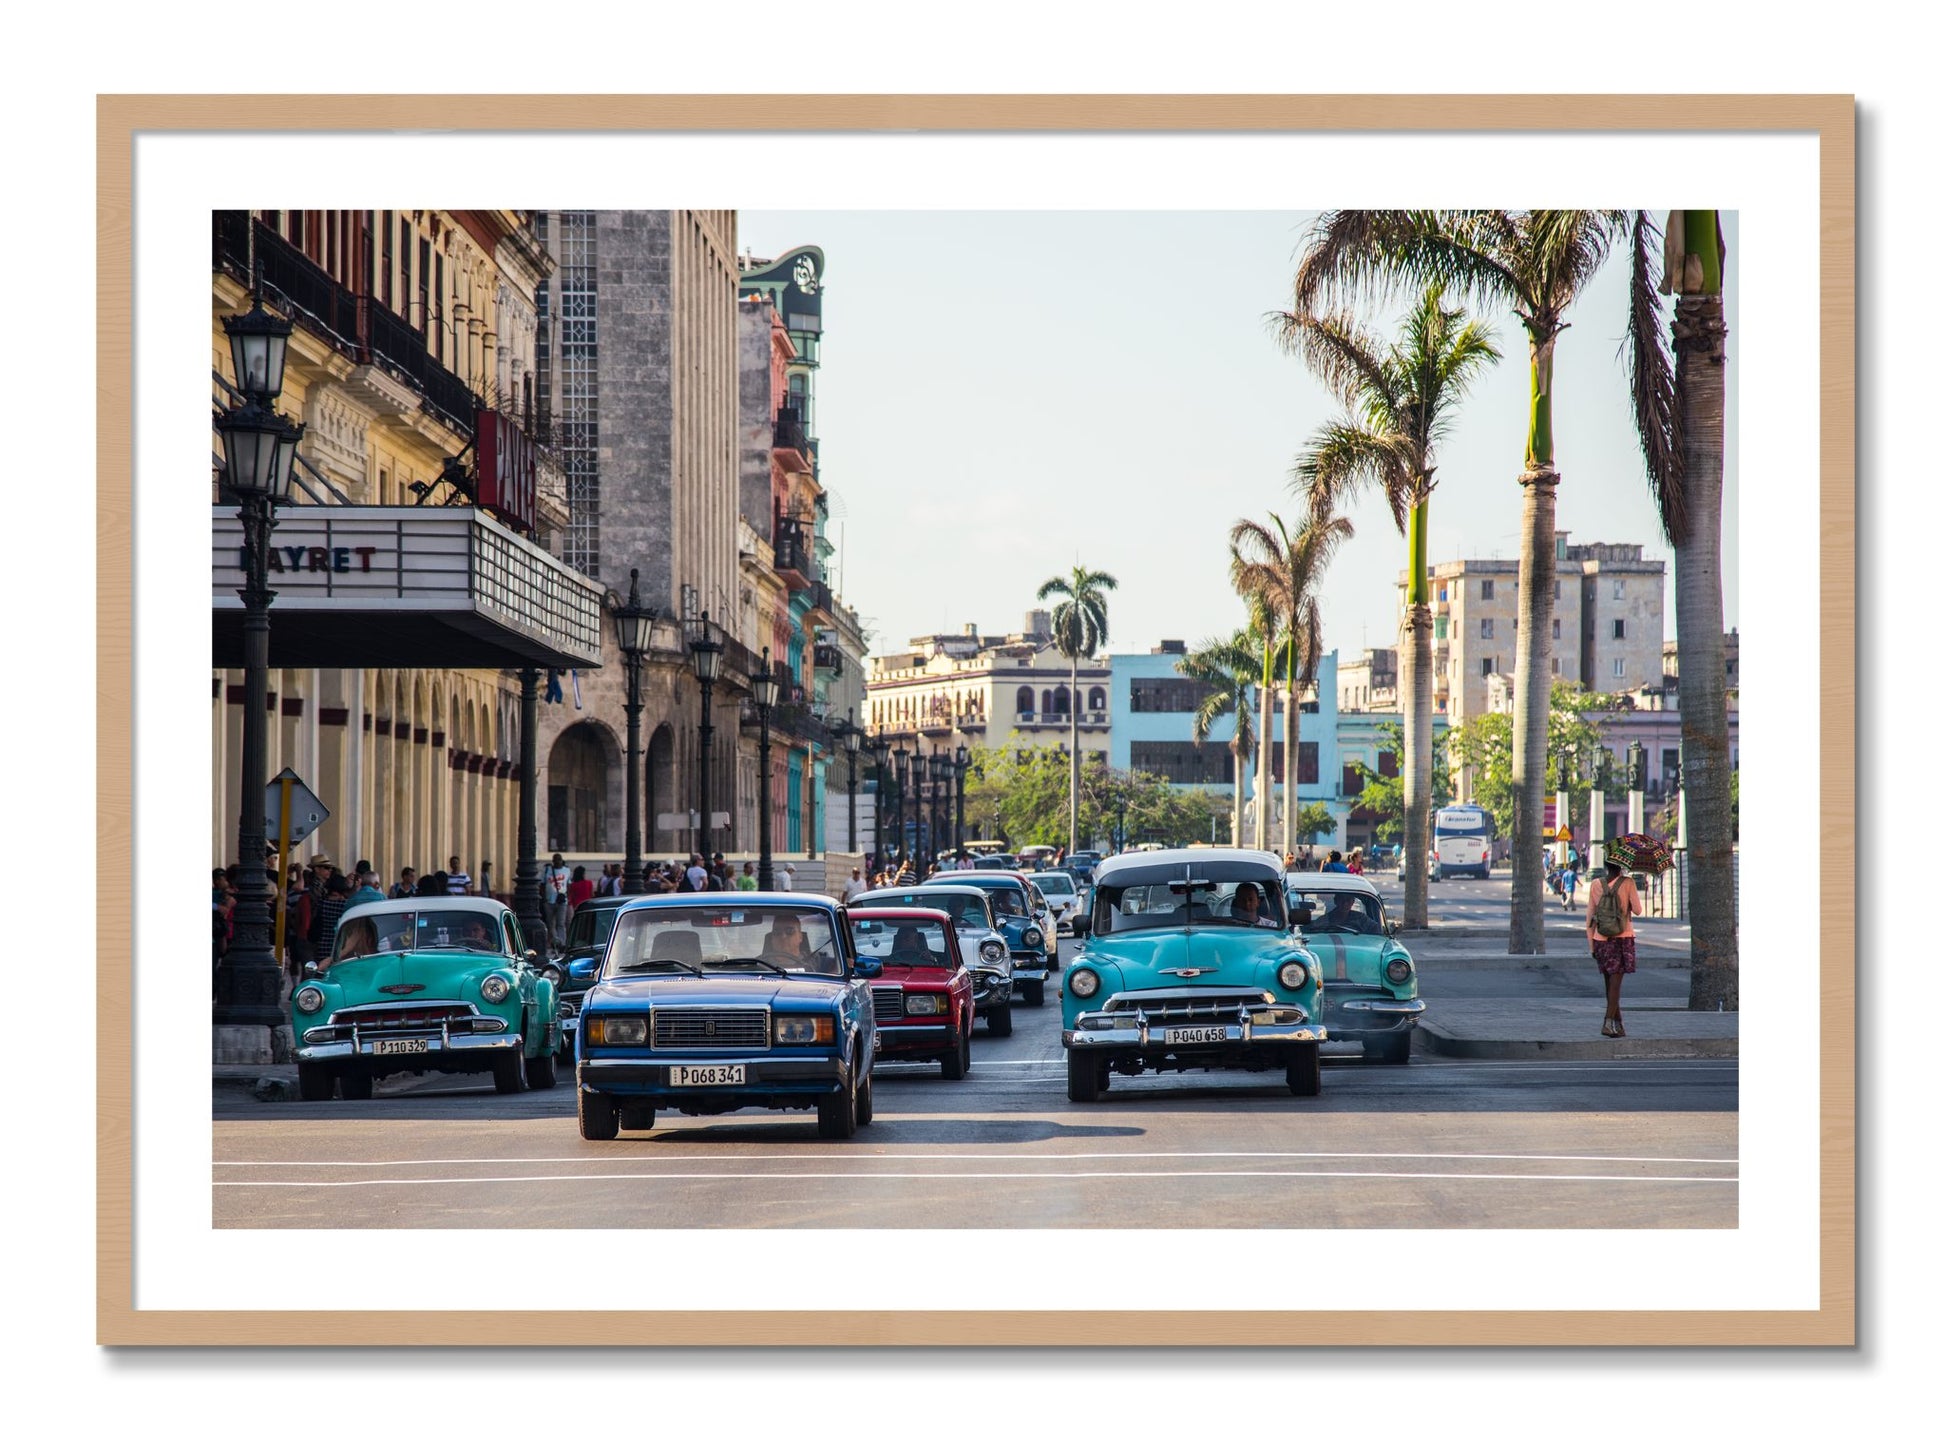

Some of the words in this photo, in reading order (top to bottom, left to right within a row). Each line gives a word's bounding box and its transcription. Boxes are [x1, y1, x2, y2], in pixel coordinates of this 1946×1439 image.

[1182, 1029, 1203, 1042] 040
[388, 1042, 407, 1053] 110
[408, 1040, 426, 1052] 329
[691, 1069, 716, 1083] 068
[718, 1066, 742, 1083] 341
